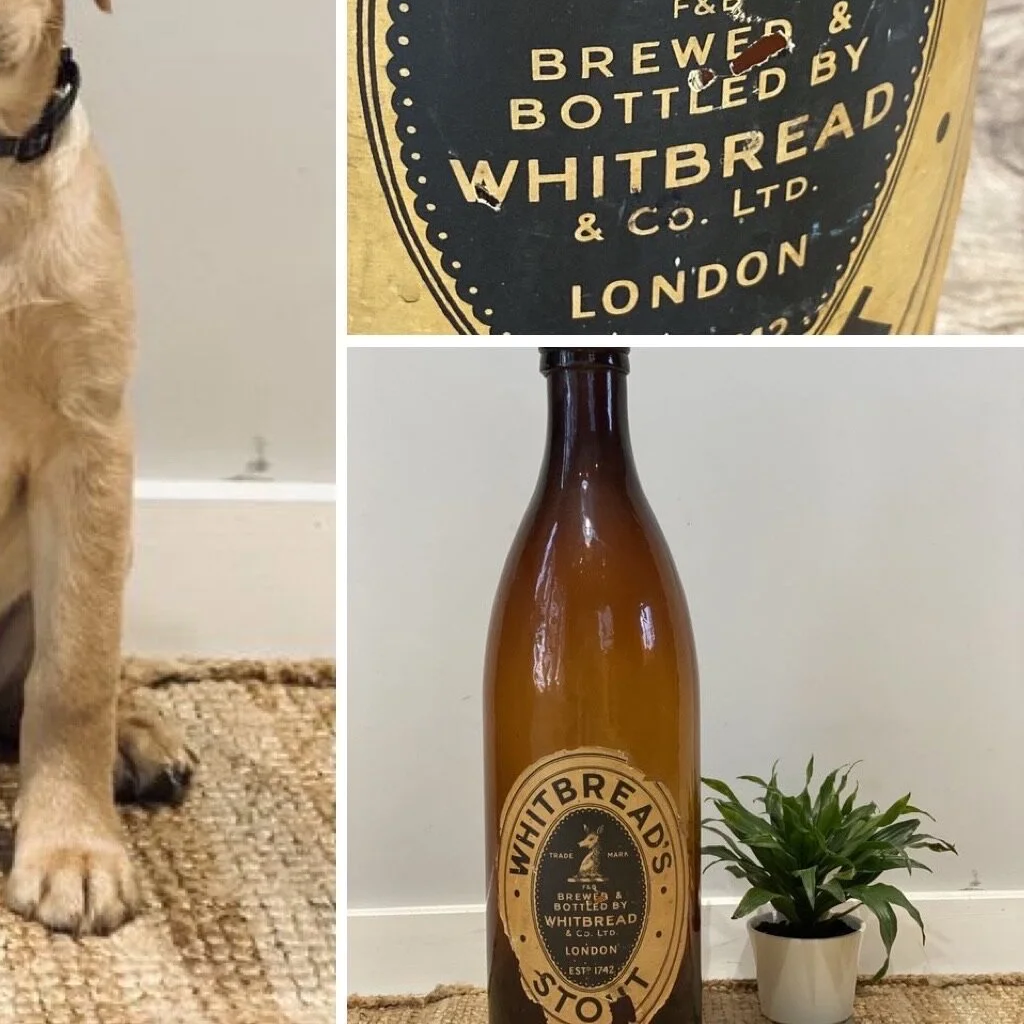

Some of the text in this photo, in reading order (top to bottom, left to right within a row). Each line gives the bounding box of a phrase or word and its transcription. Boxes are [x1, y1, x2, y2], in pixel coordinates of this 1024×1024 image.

[829, 0, 852, 33] &
[510, 38, 869, 131] BOTTLED BY
[449, 82, 896, 204] WHITBREAD
[574, 212, 604, 241] &
[571, 234, 808, 318] LONDON
[509, 773, 672, 875] WHITBREAD'S
[545, 913, 637, 928] WHITBREAD
[553, 901, 628, 912] BOTTLED BY
[565, 945, 617, 956] LONDON
[594, 966, 614, 975] 1742
[533, 967, 649, 1023] STOT
